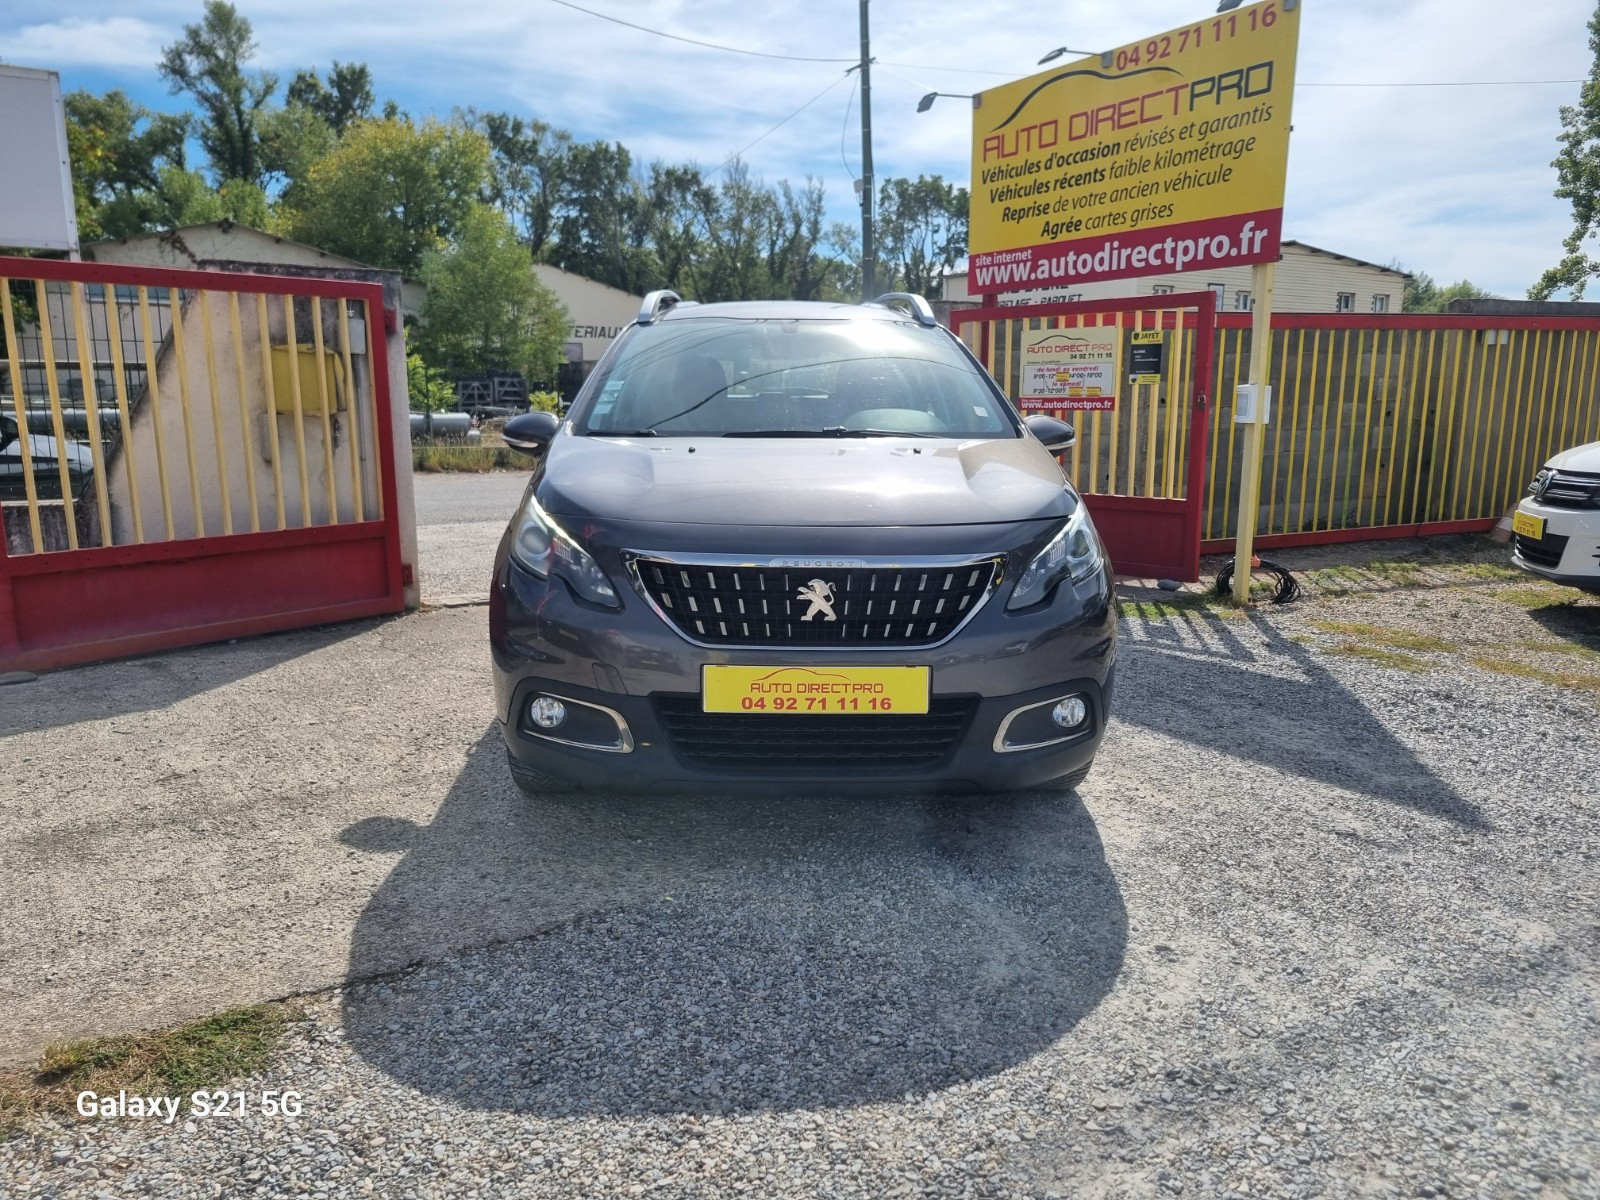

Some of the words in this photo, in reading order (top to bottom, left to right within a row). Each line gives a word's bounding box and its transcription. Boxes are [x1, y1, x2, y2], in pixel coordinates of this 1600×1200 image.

[1116, 46, 1140, 71] 04
[1145, 36, 1171, 63] 92
[1178, 26, 1202, 53] 71
[1212, 15, 1236, 42] 11
[1248, 3, 1277, 31] 16
[981, 159, 1041, 185] Véhicules
[1044, 141, 1121, 171] d'occasion
[1124, 126, 1175, 153] révisés
[1178, 121, 1196, 140] et
[1197, 102, 1273, 141] garantis
[983, 119, 1058, 163] AUTO
[990, 179, 1051, 204] Véhicules
[1053, 168, 1106, 191] récents
[1107, 155, 1151, 180] faible
[1154, 136, 1256, 171] kilométrage
[1002, 201, 1051, 224] Reprise
[1053, 195, 1069, 213] de
[1072, 191, 1107, 210] votre
[1110, 181, 1159, 203] ancien
[1164, 163, 1232, 193] véhicule
[1041, 216, 1083, 240] Agrée
[1085, 211, 1127, 231] cartes
[1130, 202, 1174, 227] grises
[975, 221, 1268, 287] www.autodirectpro.fr
[976, 256, 993, 267] site
[994, 249, 1033, 264] internet
[1027, 346, 1053, 354] AUTO
[1055, 344, 1090, 353] DIRECT
[1091, 343, 1113, 352] PRO
[1140, 332, 1159, 340] JAYET
[1021, 400, 1112, 410] www.autodirectpro.fr
[741, 697, 766, 710] 04
[773, 697, 798, 710] 92
[804, 697, 827, 710] 71
[836, 697, 859, 710] 11
[868, 697, 892, 710] 16
[750, 683, 792, 693] AUTO
